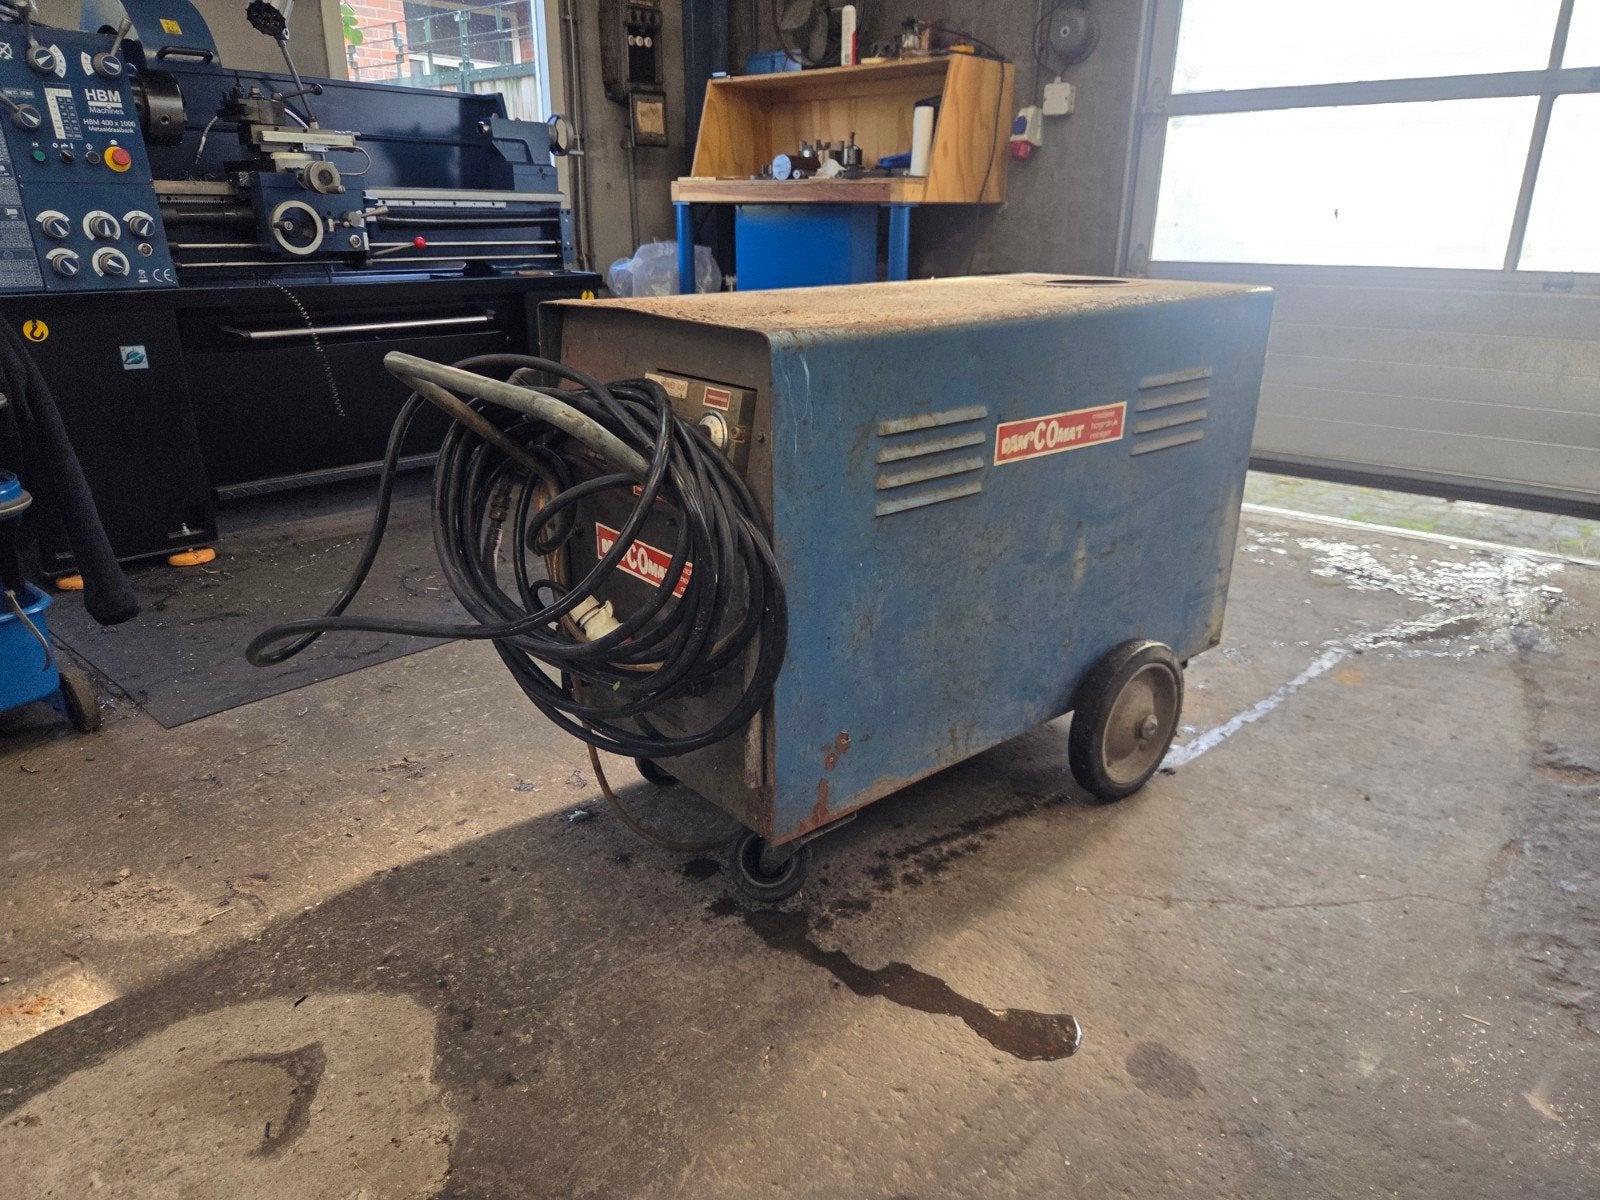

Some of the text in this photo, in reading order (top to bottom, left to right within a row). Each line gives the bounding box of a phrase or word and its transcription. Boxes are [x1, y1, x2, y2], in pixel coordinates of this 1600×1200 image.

[84, 88, 122, 103] HBM
[88, 106, 125, 115] Machines
[83, 118, 100, 126] HBM
